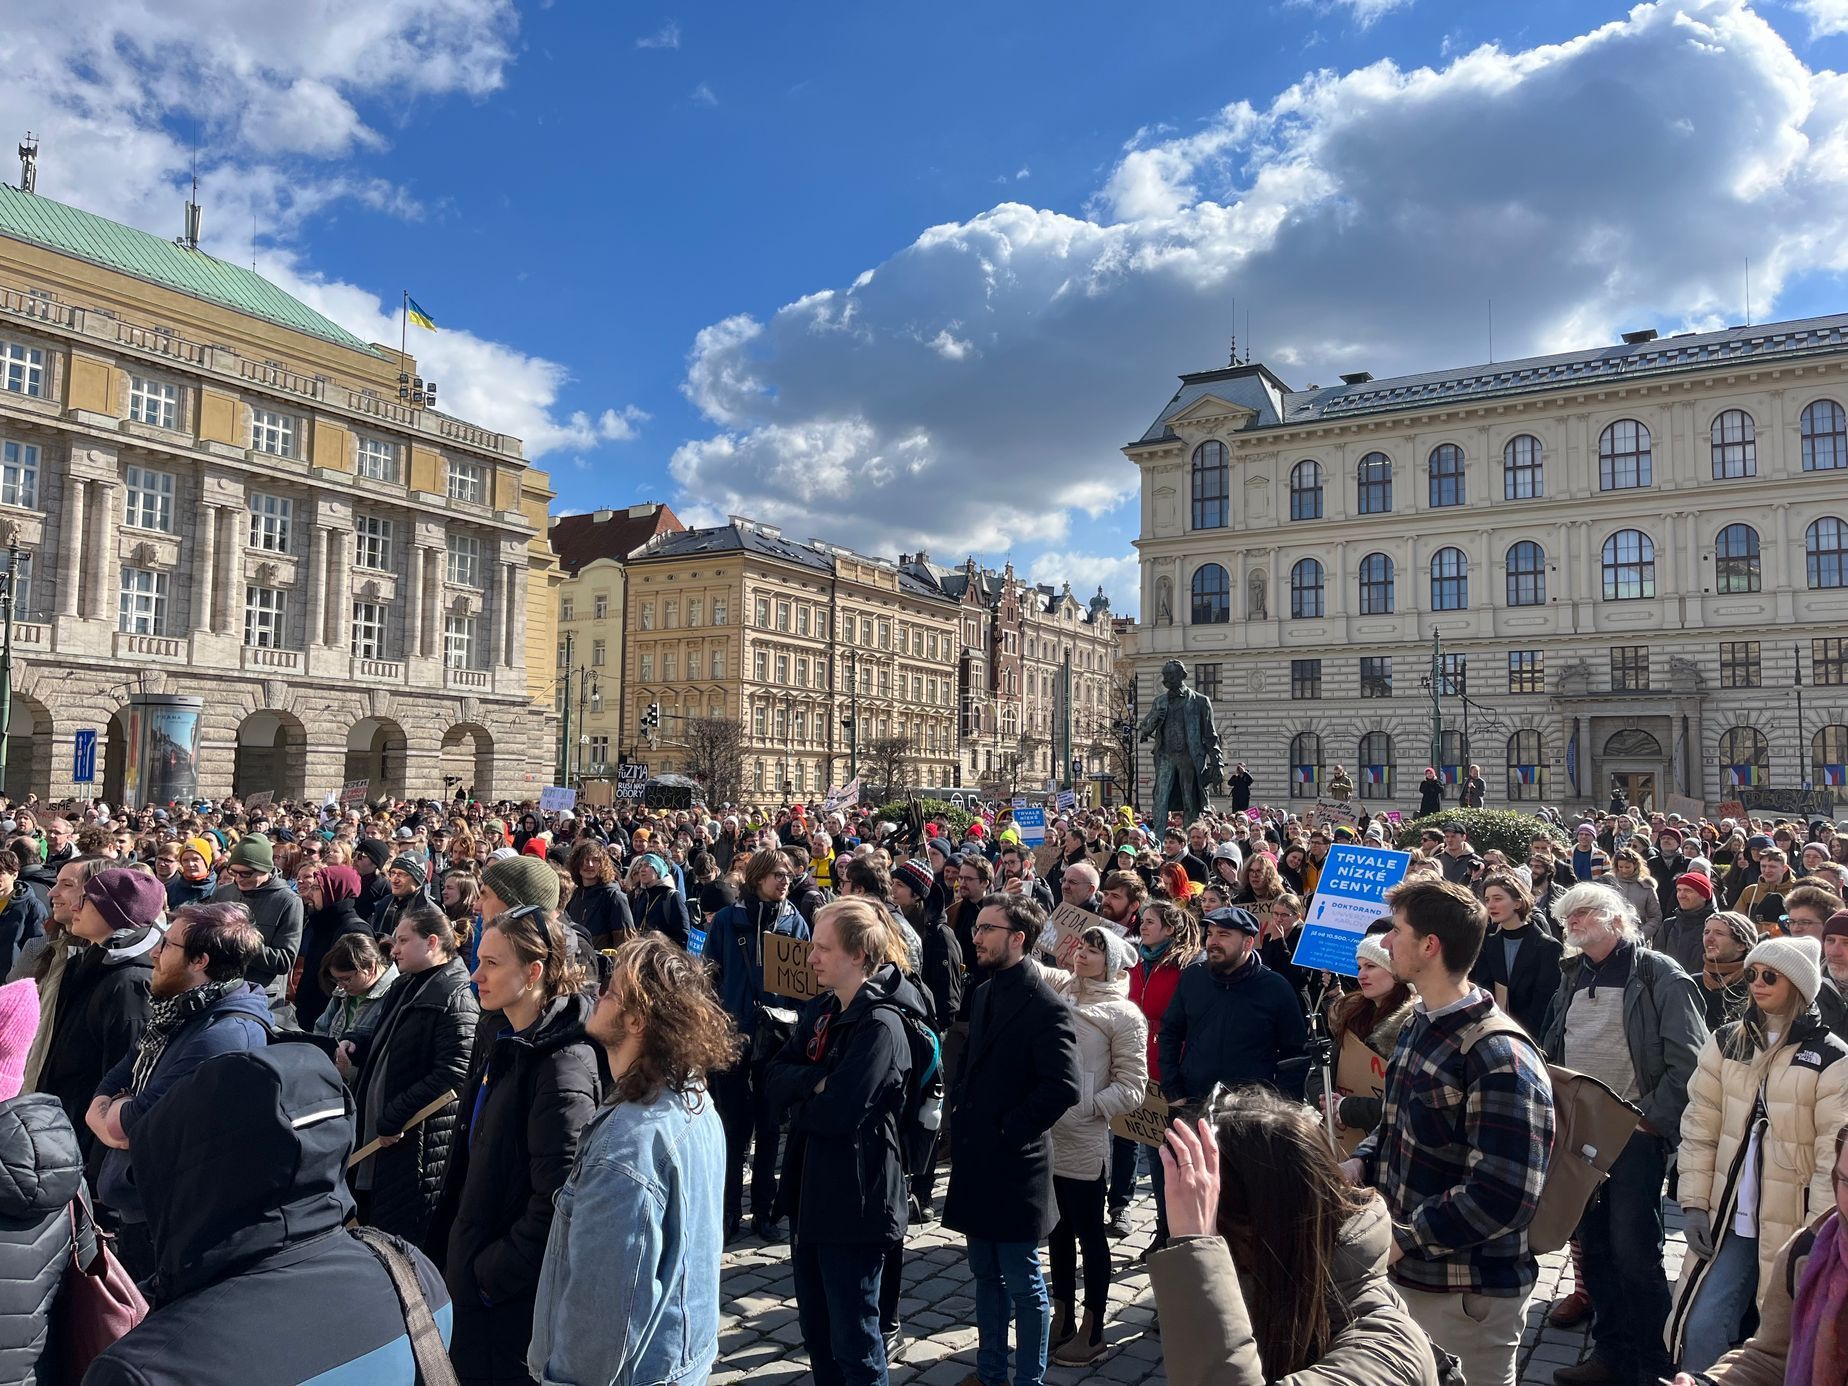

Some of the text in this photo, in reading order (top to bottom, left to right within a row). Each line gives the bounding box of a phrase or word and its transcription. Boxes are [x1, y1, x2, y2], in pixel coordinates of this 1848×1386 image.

[625, 764, 648, 779] ZIMA
[616, 789, 643, 799] OBORY
[647, 794, 690, 809] SOCKY
[1336, 852, 1398, 870] TRVALE
[1337, 865, 1387, 882] NÍZKÉ
[1329, 879, 1372, 893] CENY
[1331, 902, 1382, 916] DOKTORAND
[1055, 906, 1088, 933] VĚDA
[777, 940, 815, 970] UČÍ
